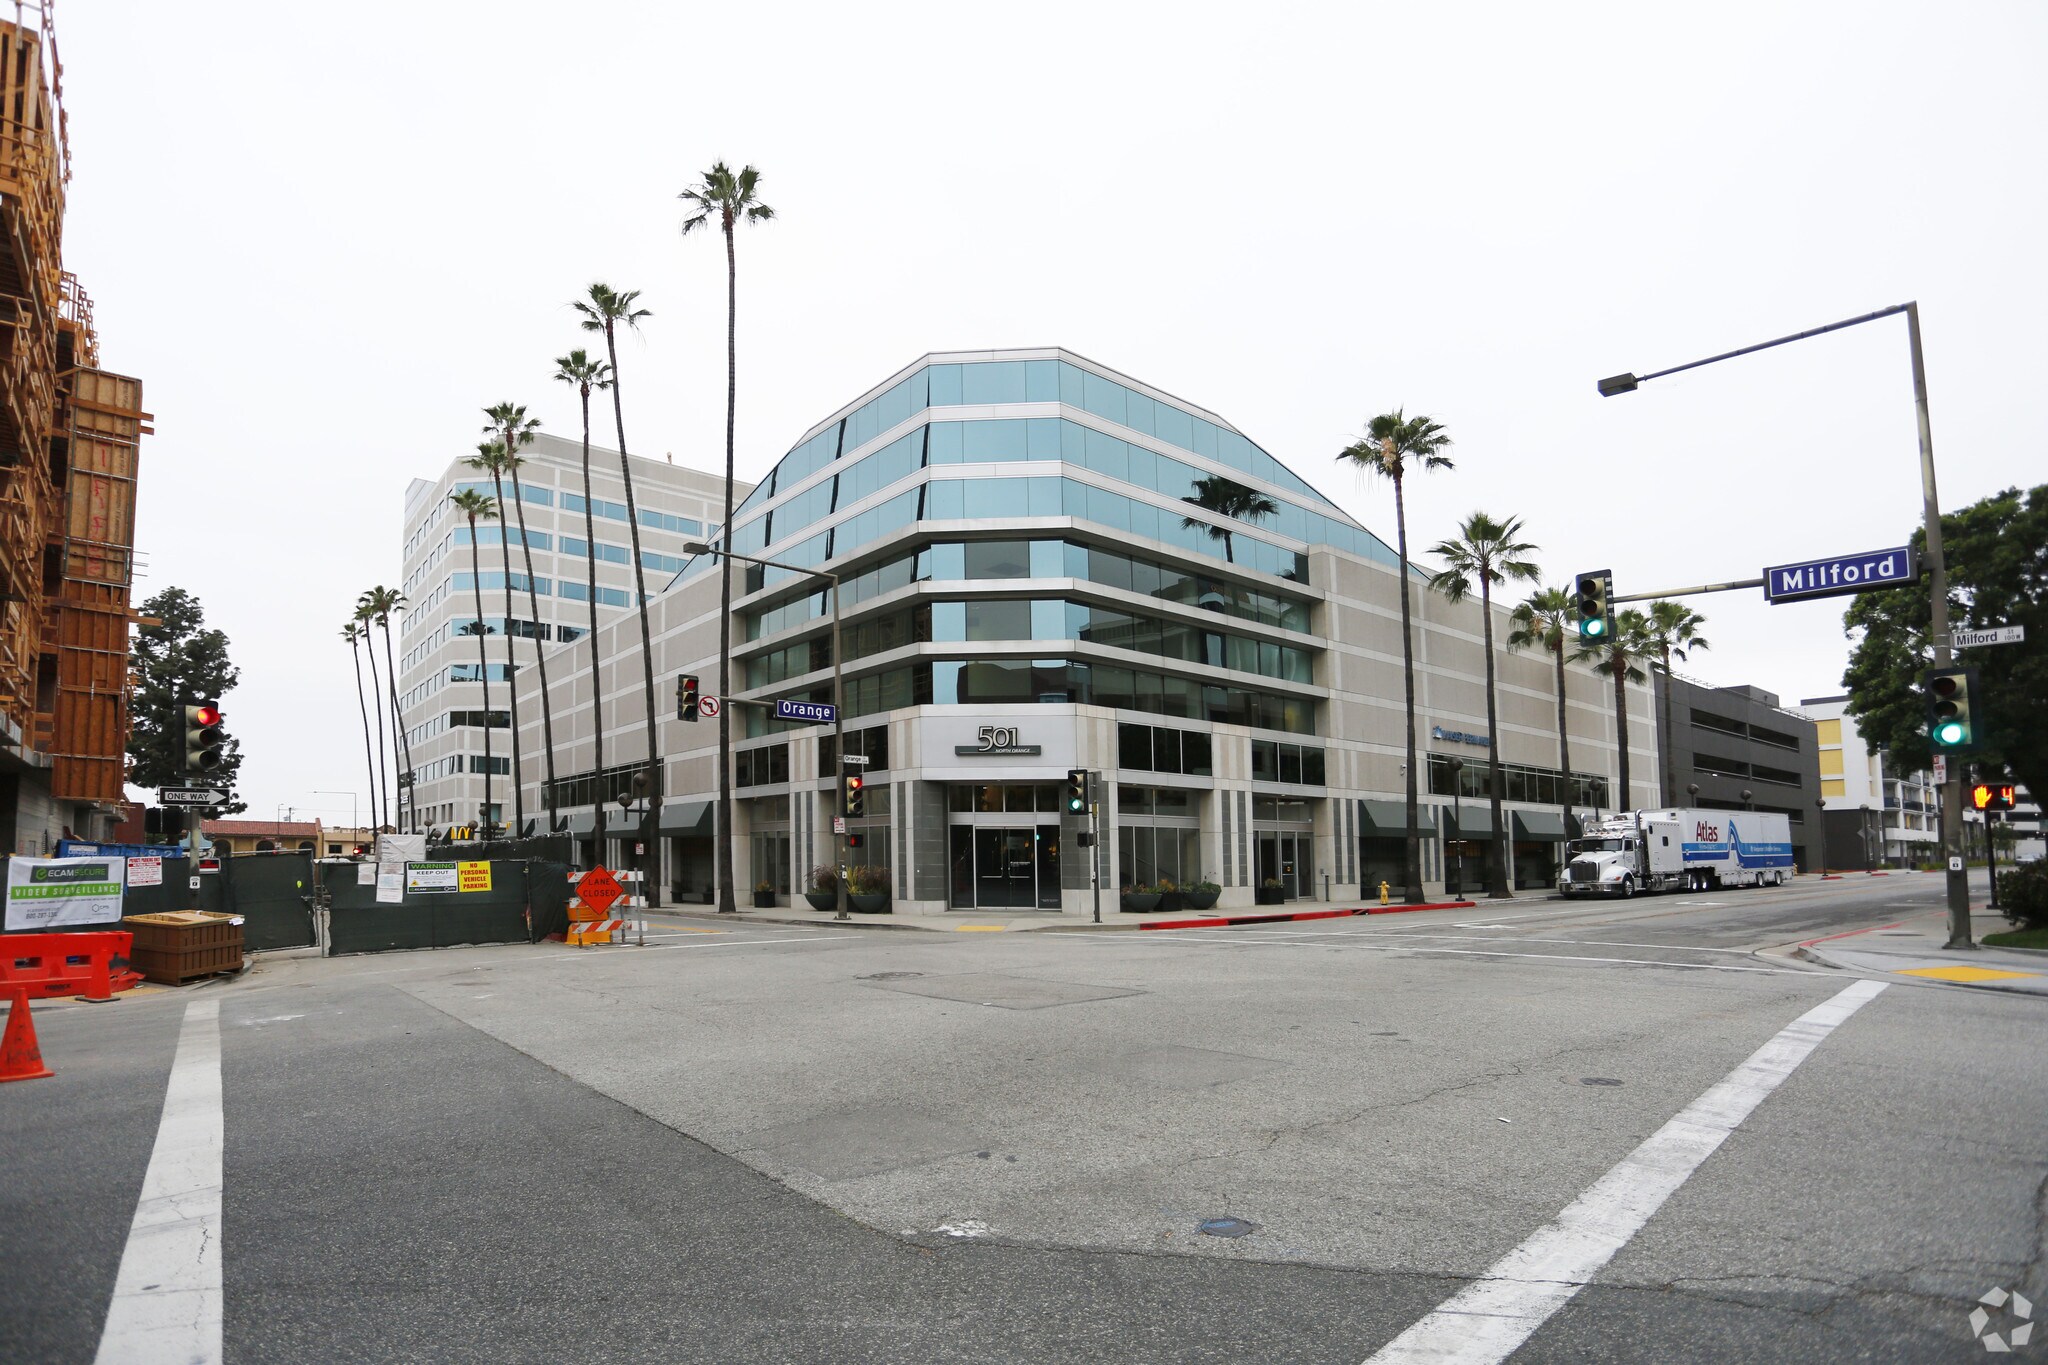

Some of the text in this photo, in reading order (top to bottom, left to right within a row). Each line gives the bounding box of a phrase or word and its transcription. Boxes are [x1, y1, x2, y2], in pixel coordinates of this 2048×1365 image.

[1782, 555, 1895, 591] Milford
[1956, 631, 1998, 646] Milford
[782, 701, 831, 720] Orange
[978, 726, 1018, 752] 501
[845, 755, 862, 763] Orange
[167, 792, 210, 800] ONE WAY
[2001, 786, 2014, 806] 4
[1696, 820, 1718, 842] Atlas
[588, 878, 611, 886] LANE
[15, 885, 119, 897] VIDEO SURVEILLANCE
[583, 889, 616, 898] CLOSED
